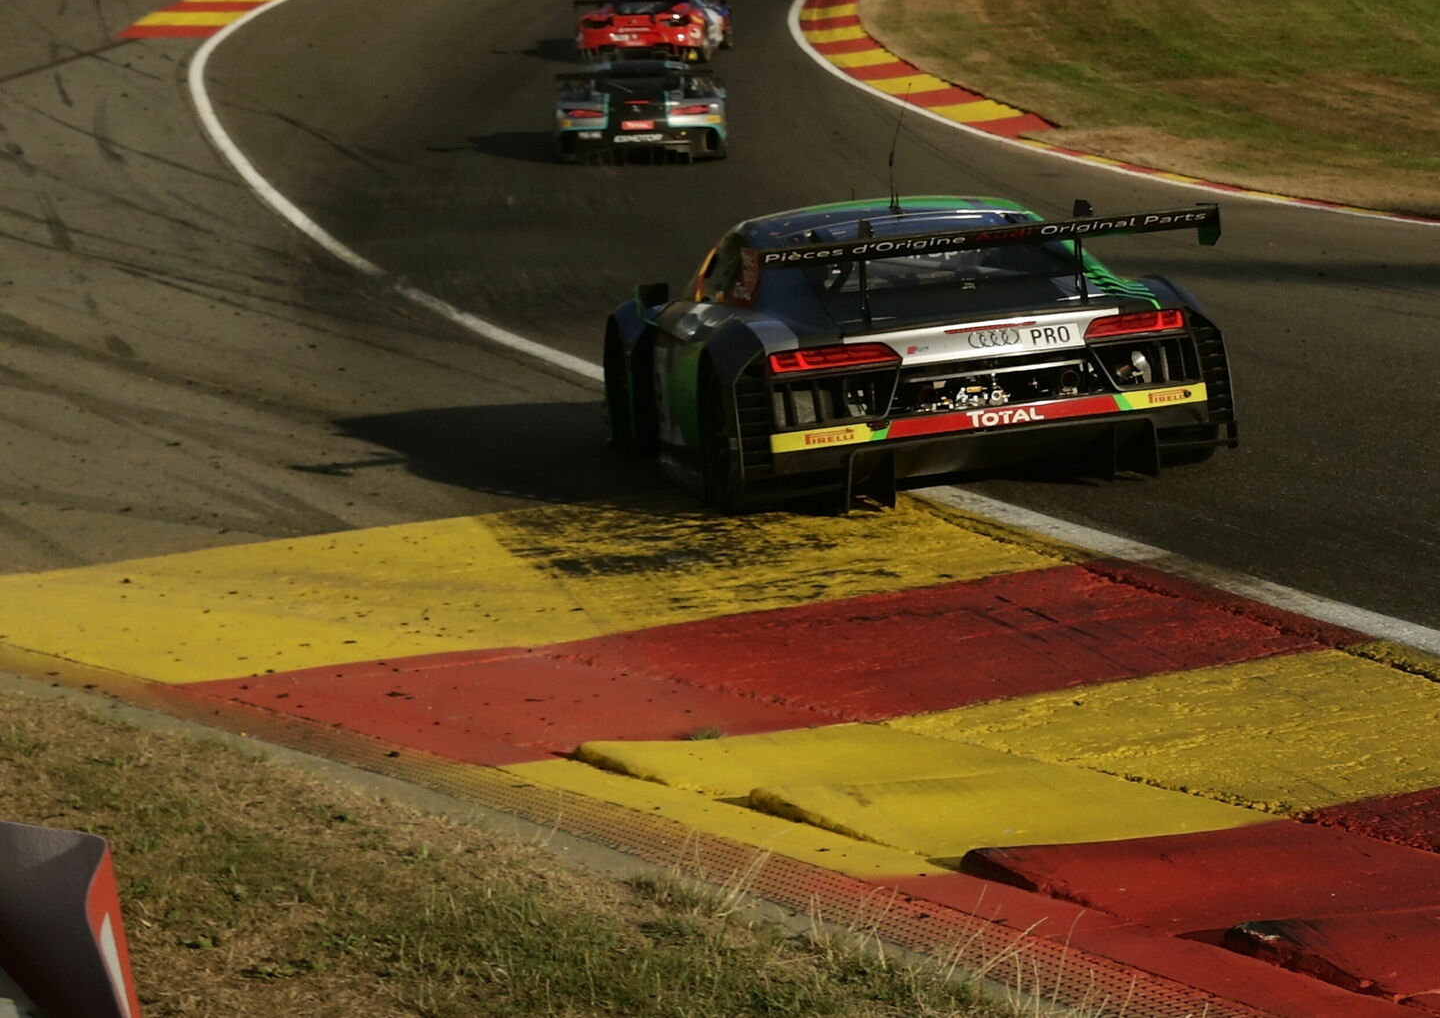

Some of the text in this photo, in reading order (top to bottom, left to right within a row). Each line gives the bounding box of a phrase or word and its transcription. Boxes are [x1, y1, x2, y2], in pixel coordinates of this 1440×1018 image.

[764, 247, 844, 264] Pièces
[851, 235, 967, 256] d'Origine
[973, 227, 1033, 242] Audi
[1040, 215, 1136, 236] Original
[1143, 211, 1208, 226] Parts
[1030, 325, 1071, 345] PRO
[966, 406, 1045, 428] TOTAL
[805, 428, 855, 445] PIRELLI
